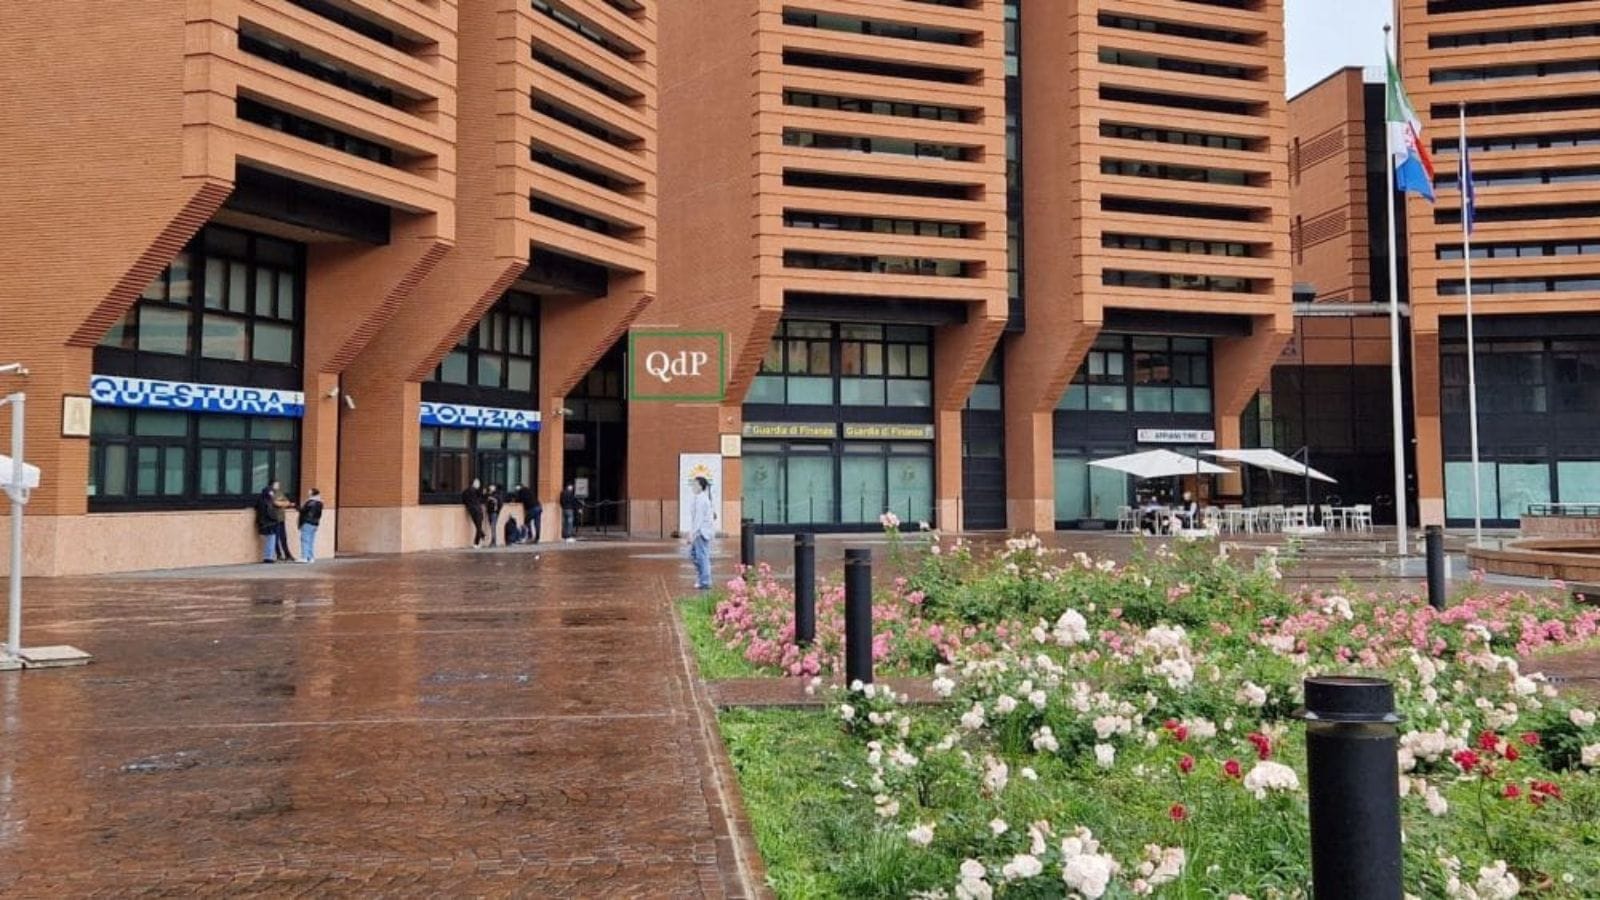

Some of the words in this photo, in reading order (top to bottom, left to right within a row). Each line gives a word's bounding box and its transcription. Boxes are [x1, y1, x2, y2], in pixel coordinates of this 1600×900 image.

[91, 377, 285, 414] QUESTURA
[753, 425, 787, 436] Guardia
[847, 426, 881, 437] Guardia
